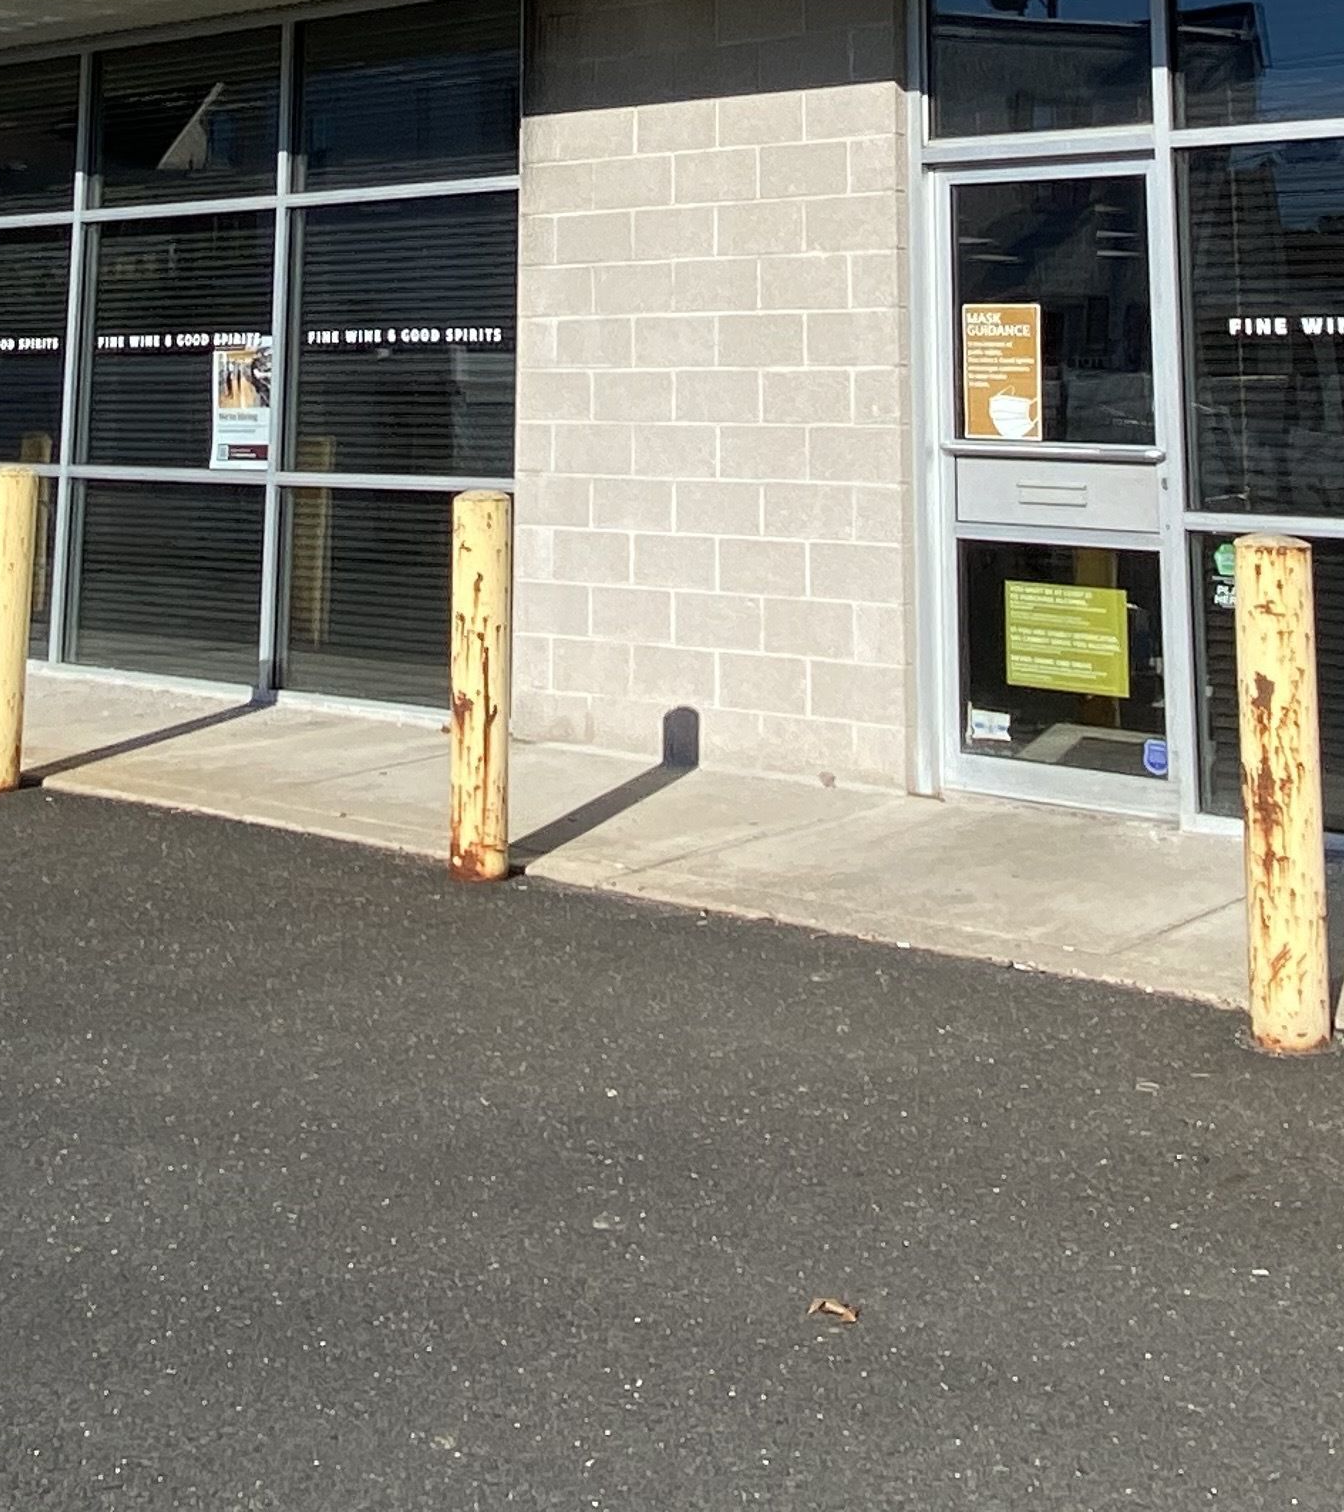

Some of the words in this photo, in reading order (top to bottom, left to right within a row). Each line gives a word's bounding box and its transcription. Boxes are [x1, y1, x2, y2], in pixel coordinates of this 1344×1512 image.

[966, 312, 1001, 324] MASK
[967, 324, 1031, 337] GUIDANCE
[1228, 317, 1288, 335] FINE
[18, 337, 59, 350] SPIRITS
[97, 336, 125, 349] FINE
[129, 335, 160, 348] WINE
[176, 333, 209, 347] GOOD
[213, 332, 261, 347] SPIRITS
[307, 330, 339, 345] FINE
[345, 329, 382, 344] WINE
[400, 328, 440, 343] GOOD
[445, 327, 502, 342] SPIRITS
